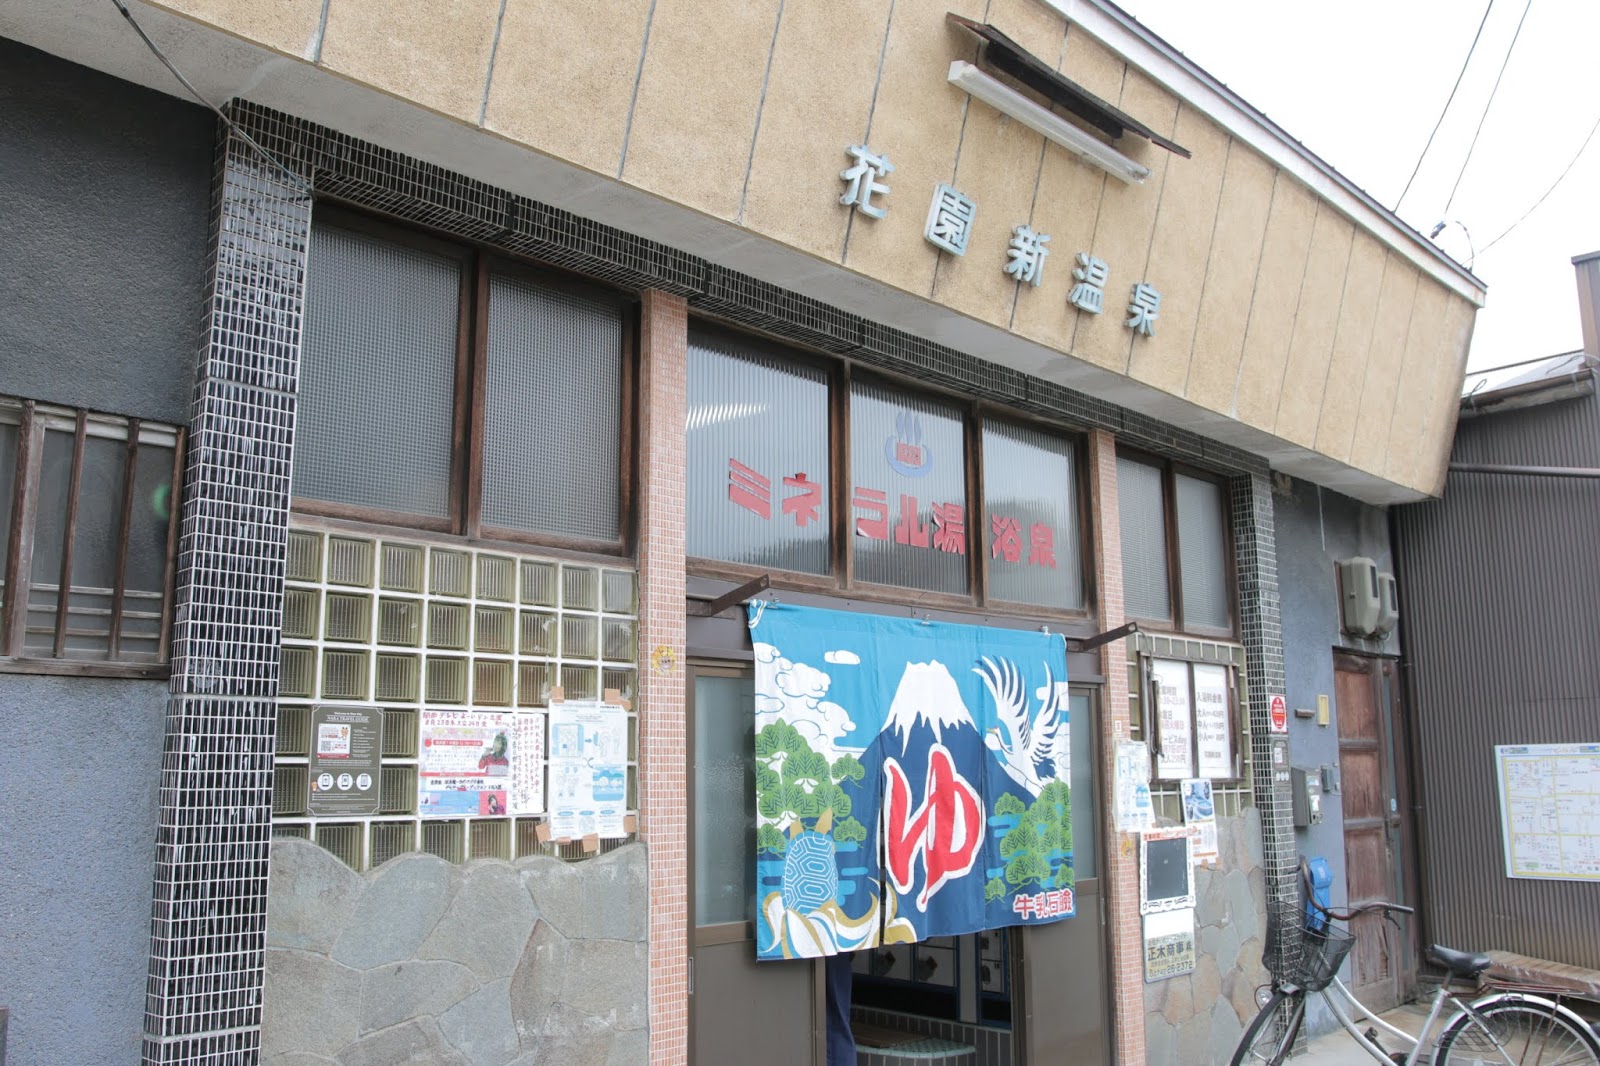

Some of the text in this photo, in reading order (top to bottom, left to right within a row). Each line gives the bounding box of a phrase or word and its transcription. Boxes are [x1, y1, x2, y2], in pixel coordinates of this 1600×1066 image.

[839, 144, 1162, 337] 花園新温泉
[1163, 735, 1187, 745] ービスday
[876, 742, 987, 913] ゆ
